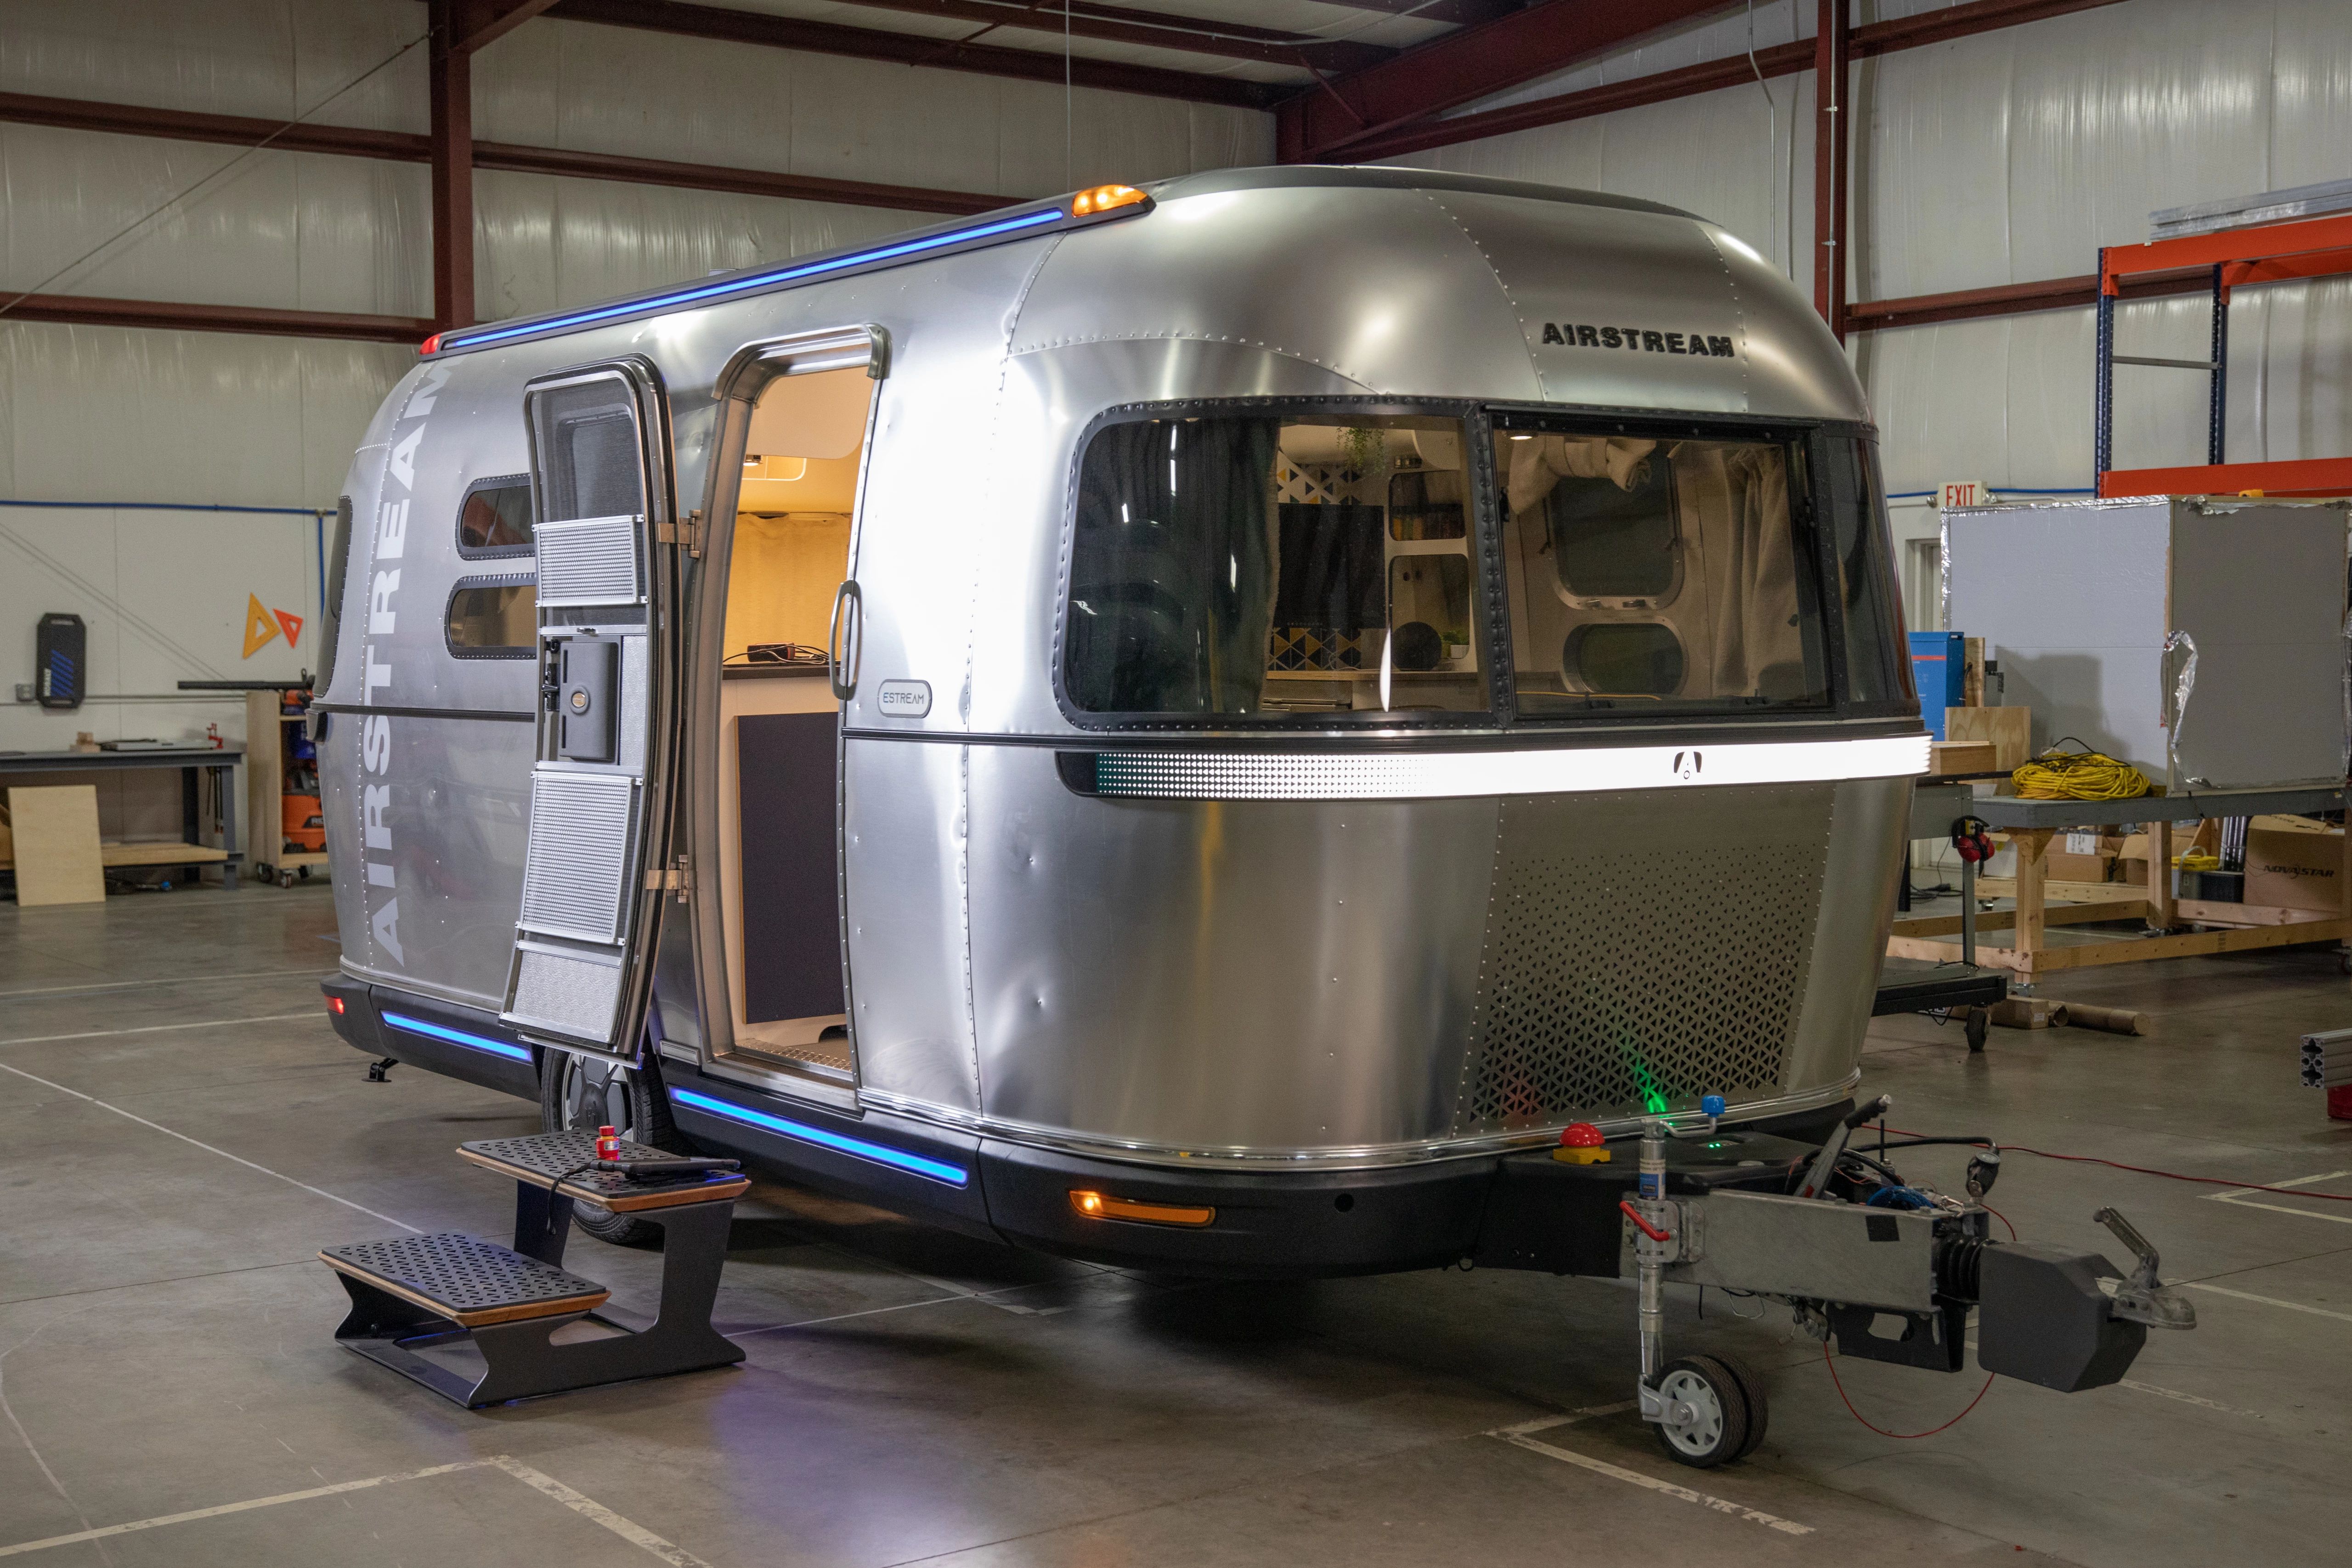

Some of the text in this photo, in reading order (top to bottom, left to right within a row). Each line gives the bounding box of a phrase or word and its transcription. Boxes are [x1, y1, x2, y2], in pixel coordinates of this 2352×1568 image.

[1542, 323, 1735, 357] AIRSTREAM
[1946, 484, 1975, 506] EXIT
[363, 355, 468, 968] AIRSTREAM
[883, 692, 924, 704] ESTREAM
[2264, 865, 2335, 877] NOVASTAR
